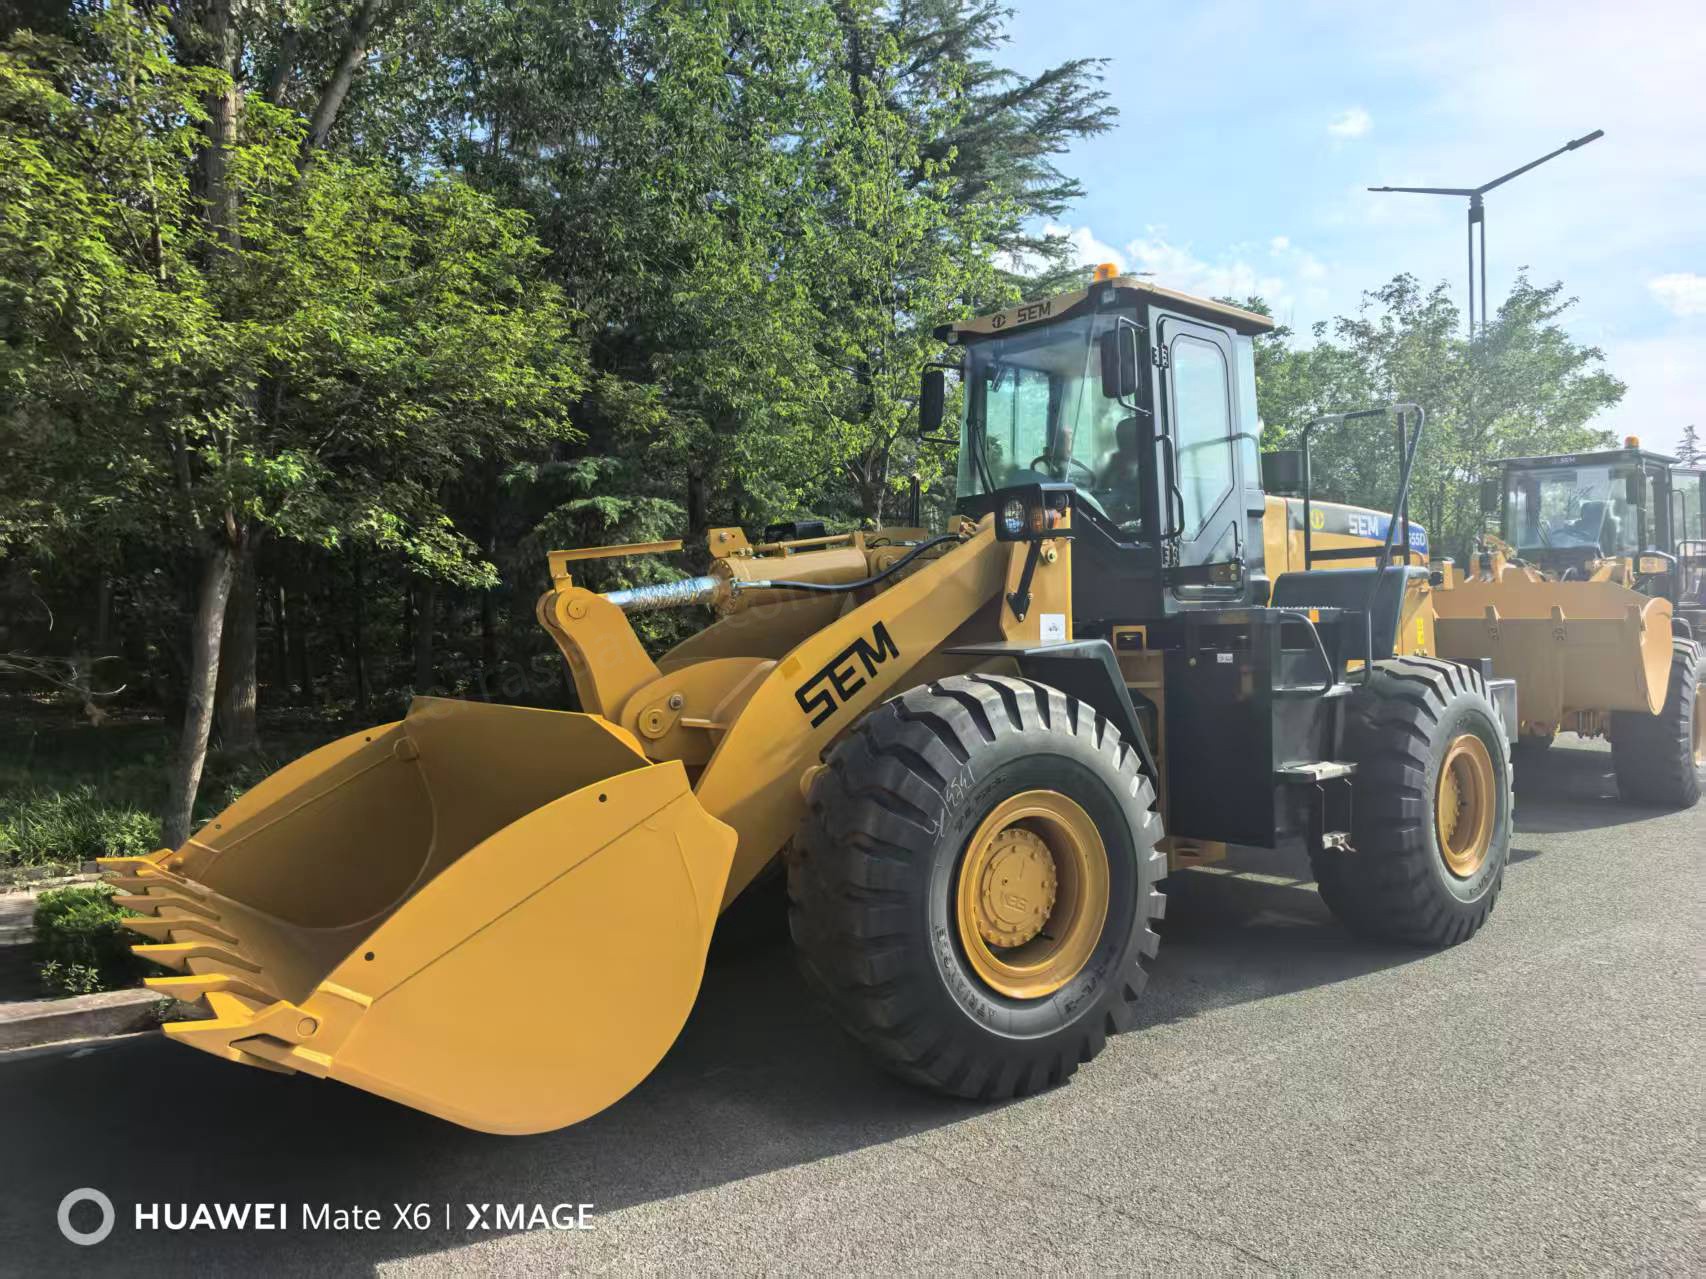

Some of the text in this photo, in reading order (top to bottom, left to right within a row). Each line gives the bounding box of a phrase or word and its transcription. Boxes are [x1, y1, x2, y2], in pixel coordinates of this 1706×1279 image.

[1017, 301, 1051, 323] SEM
[1348, 512, 1379, 537] SEM
[795, 620, 899, 729] SEM
